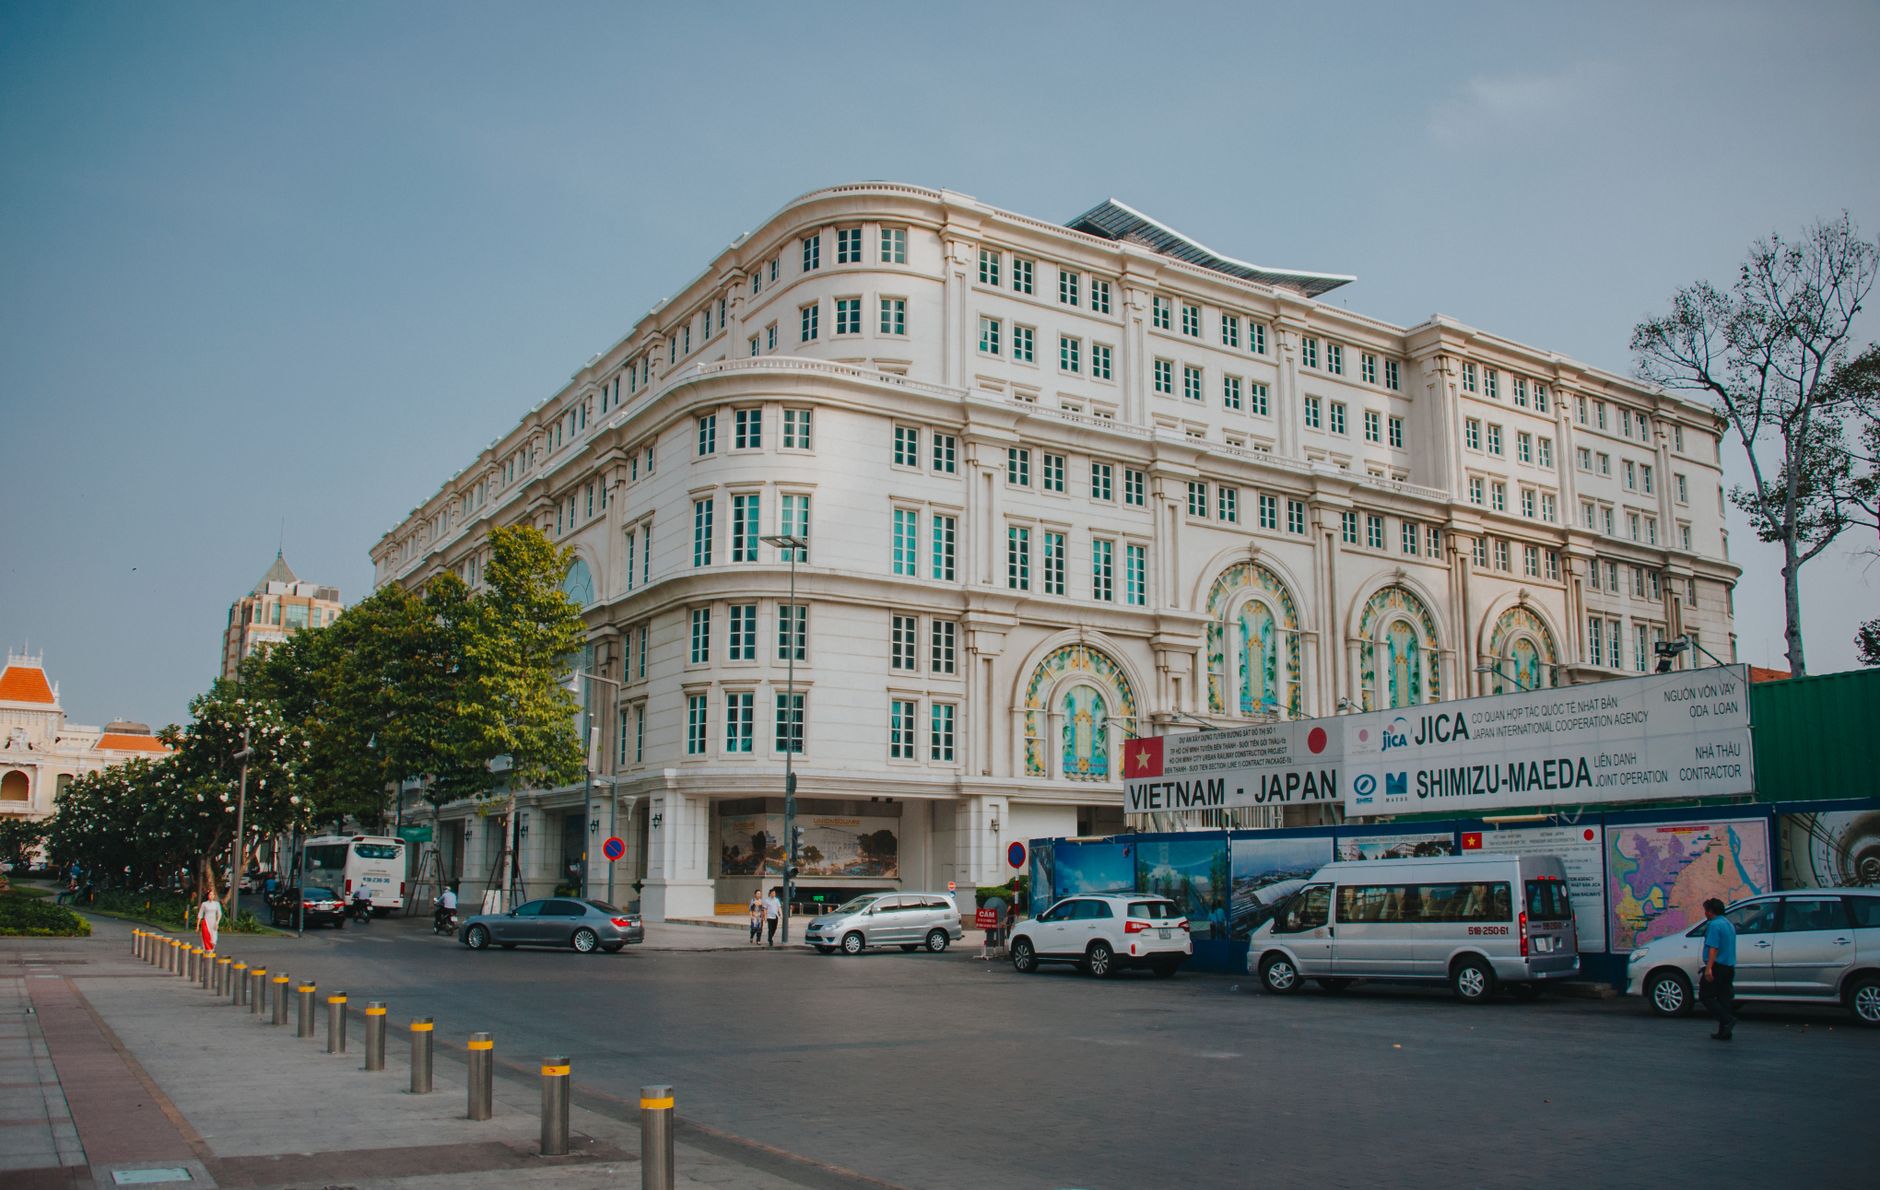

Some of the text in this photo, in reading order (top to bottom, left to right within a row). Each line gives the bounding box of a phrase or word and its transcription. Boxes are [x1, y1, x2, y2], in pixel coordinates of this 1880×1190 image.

[1484, 709, 1505, 723] QUAN
[1689, 701, 1738, 718] ODA LOAN
[1415, 712, 1470, 745] JICA
[1472, 711, 1648, 740] JAPAN INTERNATIONAL COOPERATION AGENCY
[1235, 749, 1266, 759] CONSTRUCTION
[1267, 747, 1287, 756] PROJECT
[1613, 752, 1637, 766] DANH
[1695, 742, 1714, 760] NHÀ
[1242, 758, 1264, 768] CONTRACT
[1416, 757, 1593, 799] SHIMIZU-MAEDA
[1595, 769, 1668, 788] JOINT OPERATION
[1680, 764, 1742, 781] CONTRACTOR
[1130, 778, 1224, 810] VIETNAM
[1255, 769, 1337, 803] JAPAN
